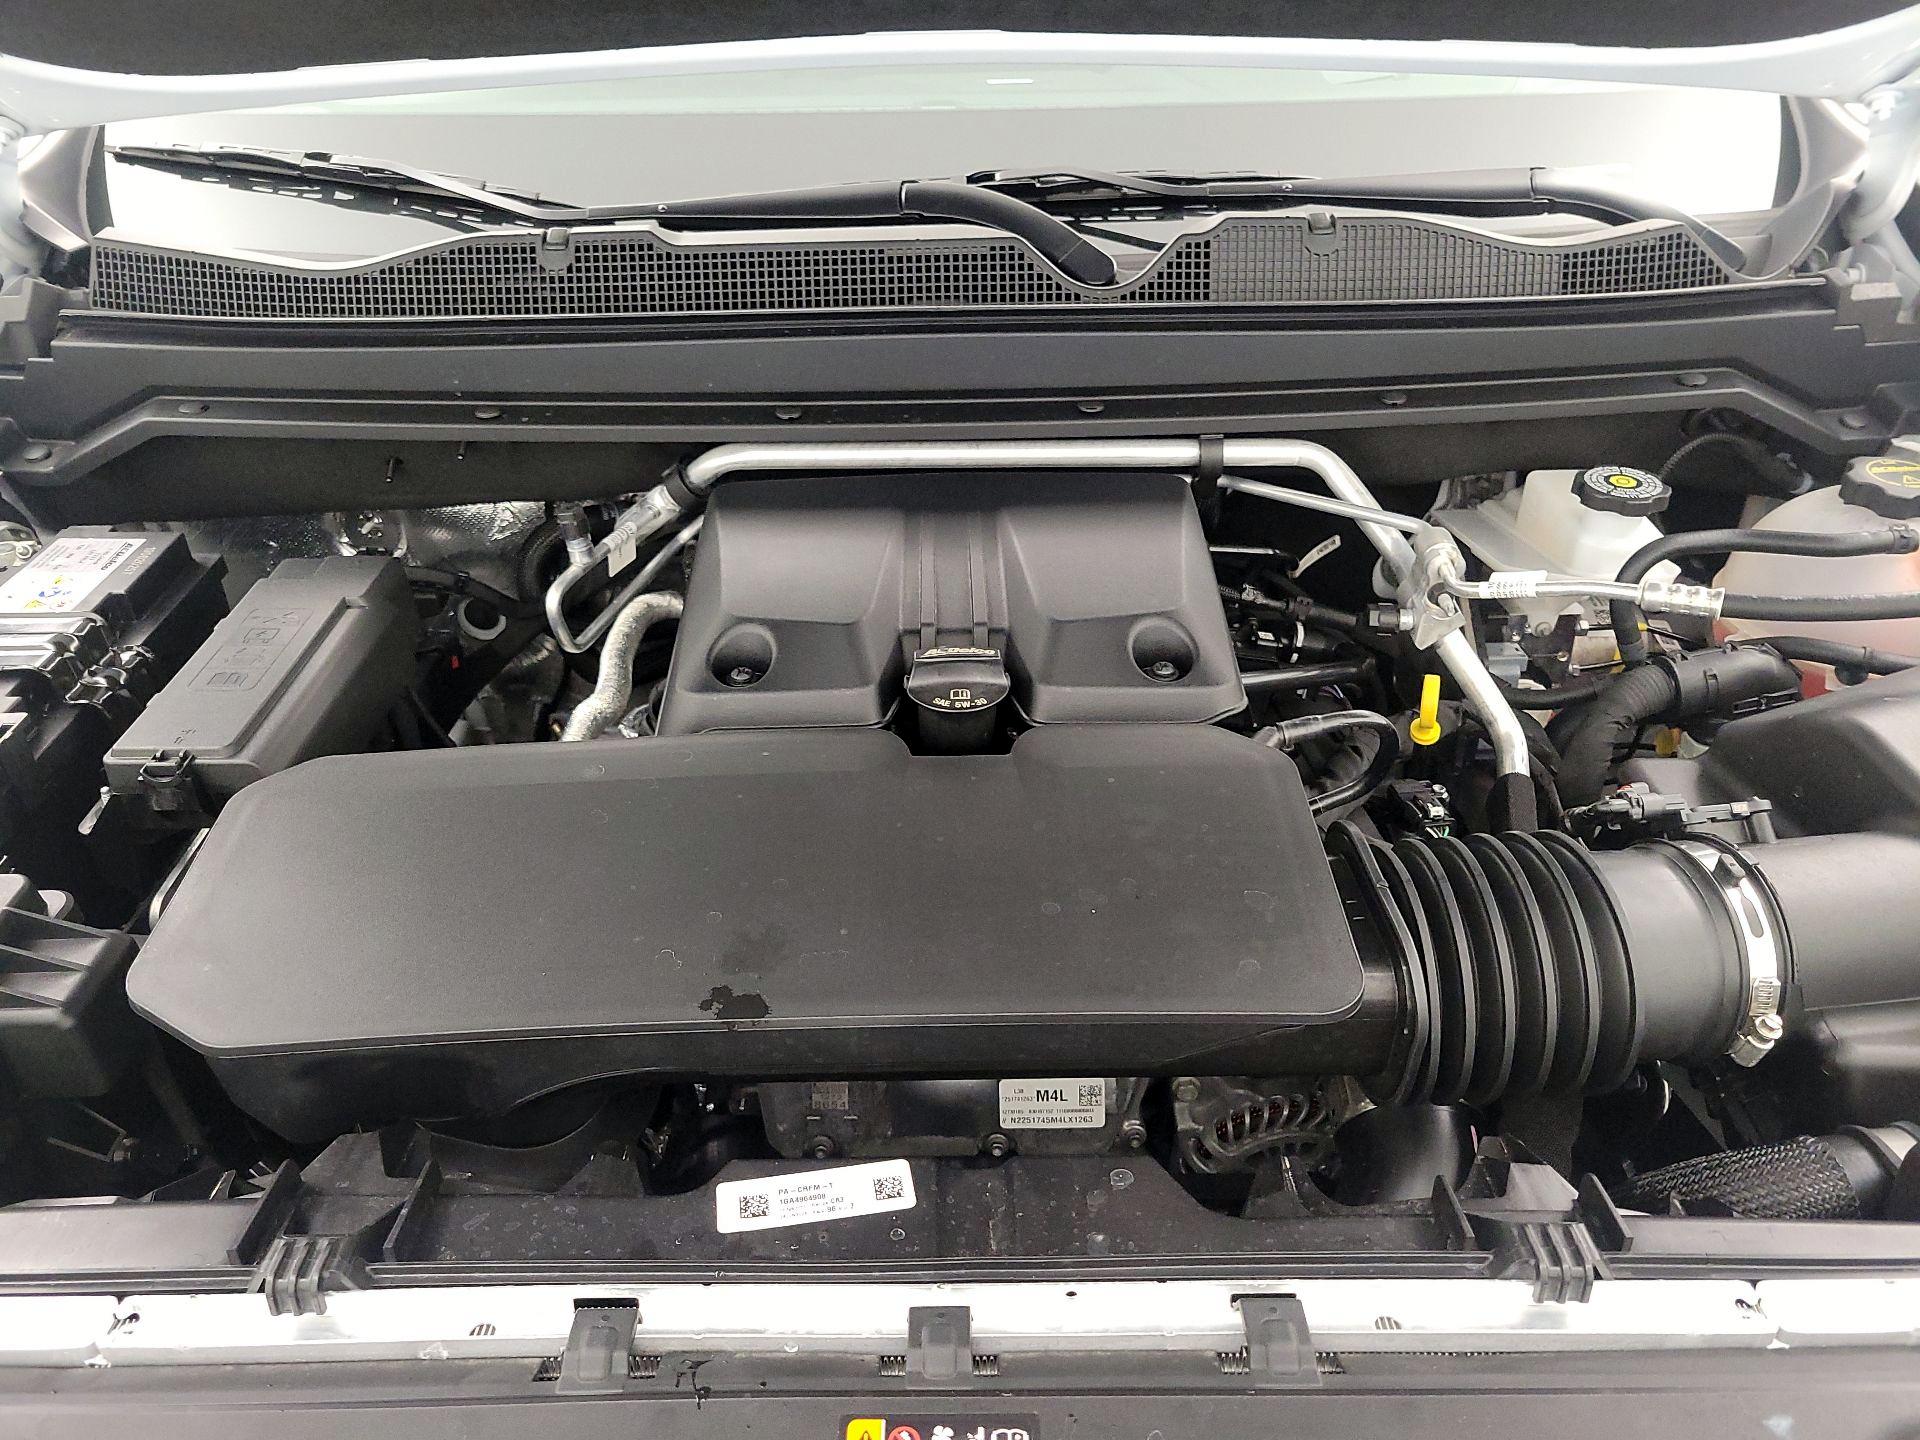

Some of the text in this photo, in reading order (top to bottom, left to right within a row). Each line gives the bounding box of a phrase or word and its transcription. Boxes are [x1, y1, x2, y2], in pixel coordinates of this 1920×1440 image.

[920, 647, 996, 658] ACDelco
[932, 697, 952, 707] SAE
[1036, 1089, 1069, 1102] M4L
[1010, 1115, 1094, 1124] N2251745M4LX1263
